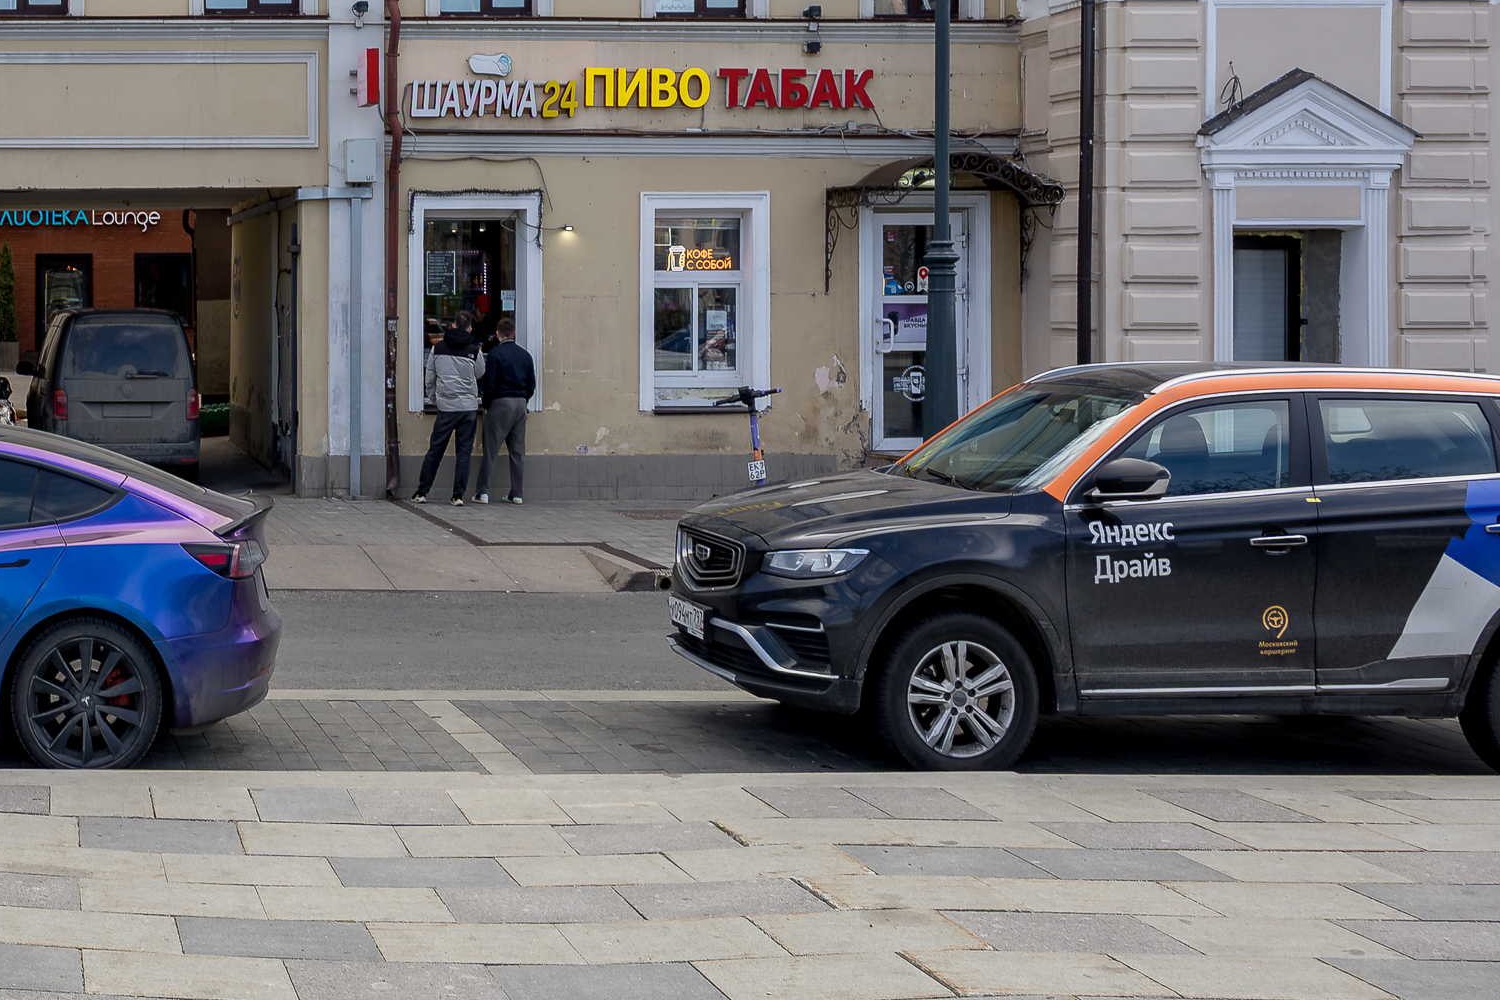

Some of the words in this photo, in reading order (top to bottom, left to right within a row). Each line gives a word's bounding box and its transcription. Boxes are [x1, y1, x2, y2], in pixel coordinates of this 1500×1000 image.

[410, 79, 538, 118] ШАУРМА
[541, 80, 579, 118] 24
[584, 67, 711, 109] ПИВО
[717, 67, 876, 109] ТАБАК
[92, 209, 161, 233] Lounge
[686, 248, 713, 260] КОФЕ
[686, 259, 694, 270] С
[695, 257, 732, 270] СОБОЙ
[1088, 520, 1175, 546] Яндекс
[1094, 552, 1172, 584] Драйв
[1258, 639, 1298, 648] Московский
